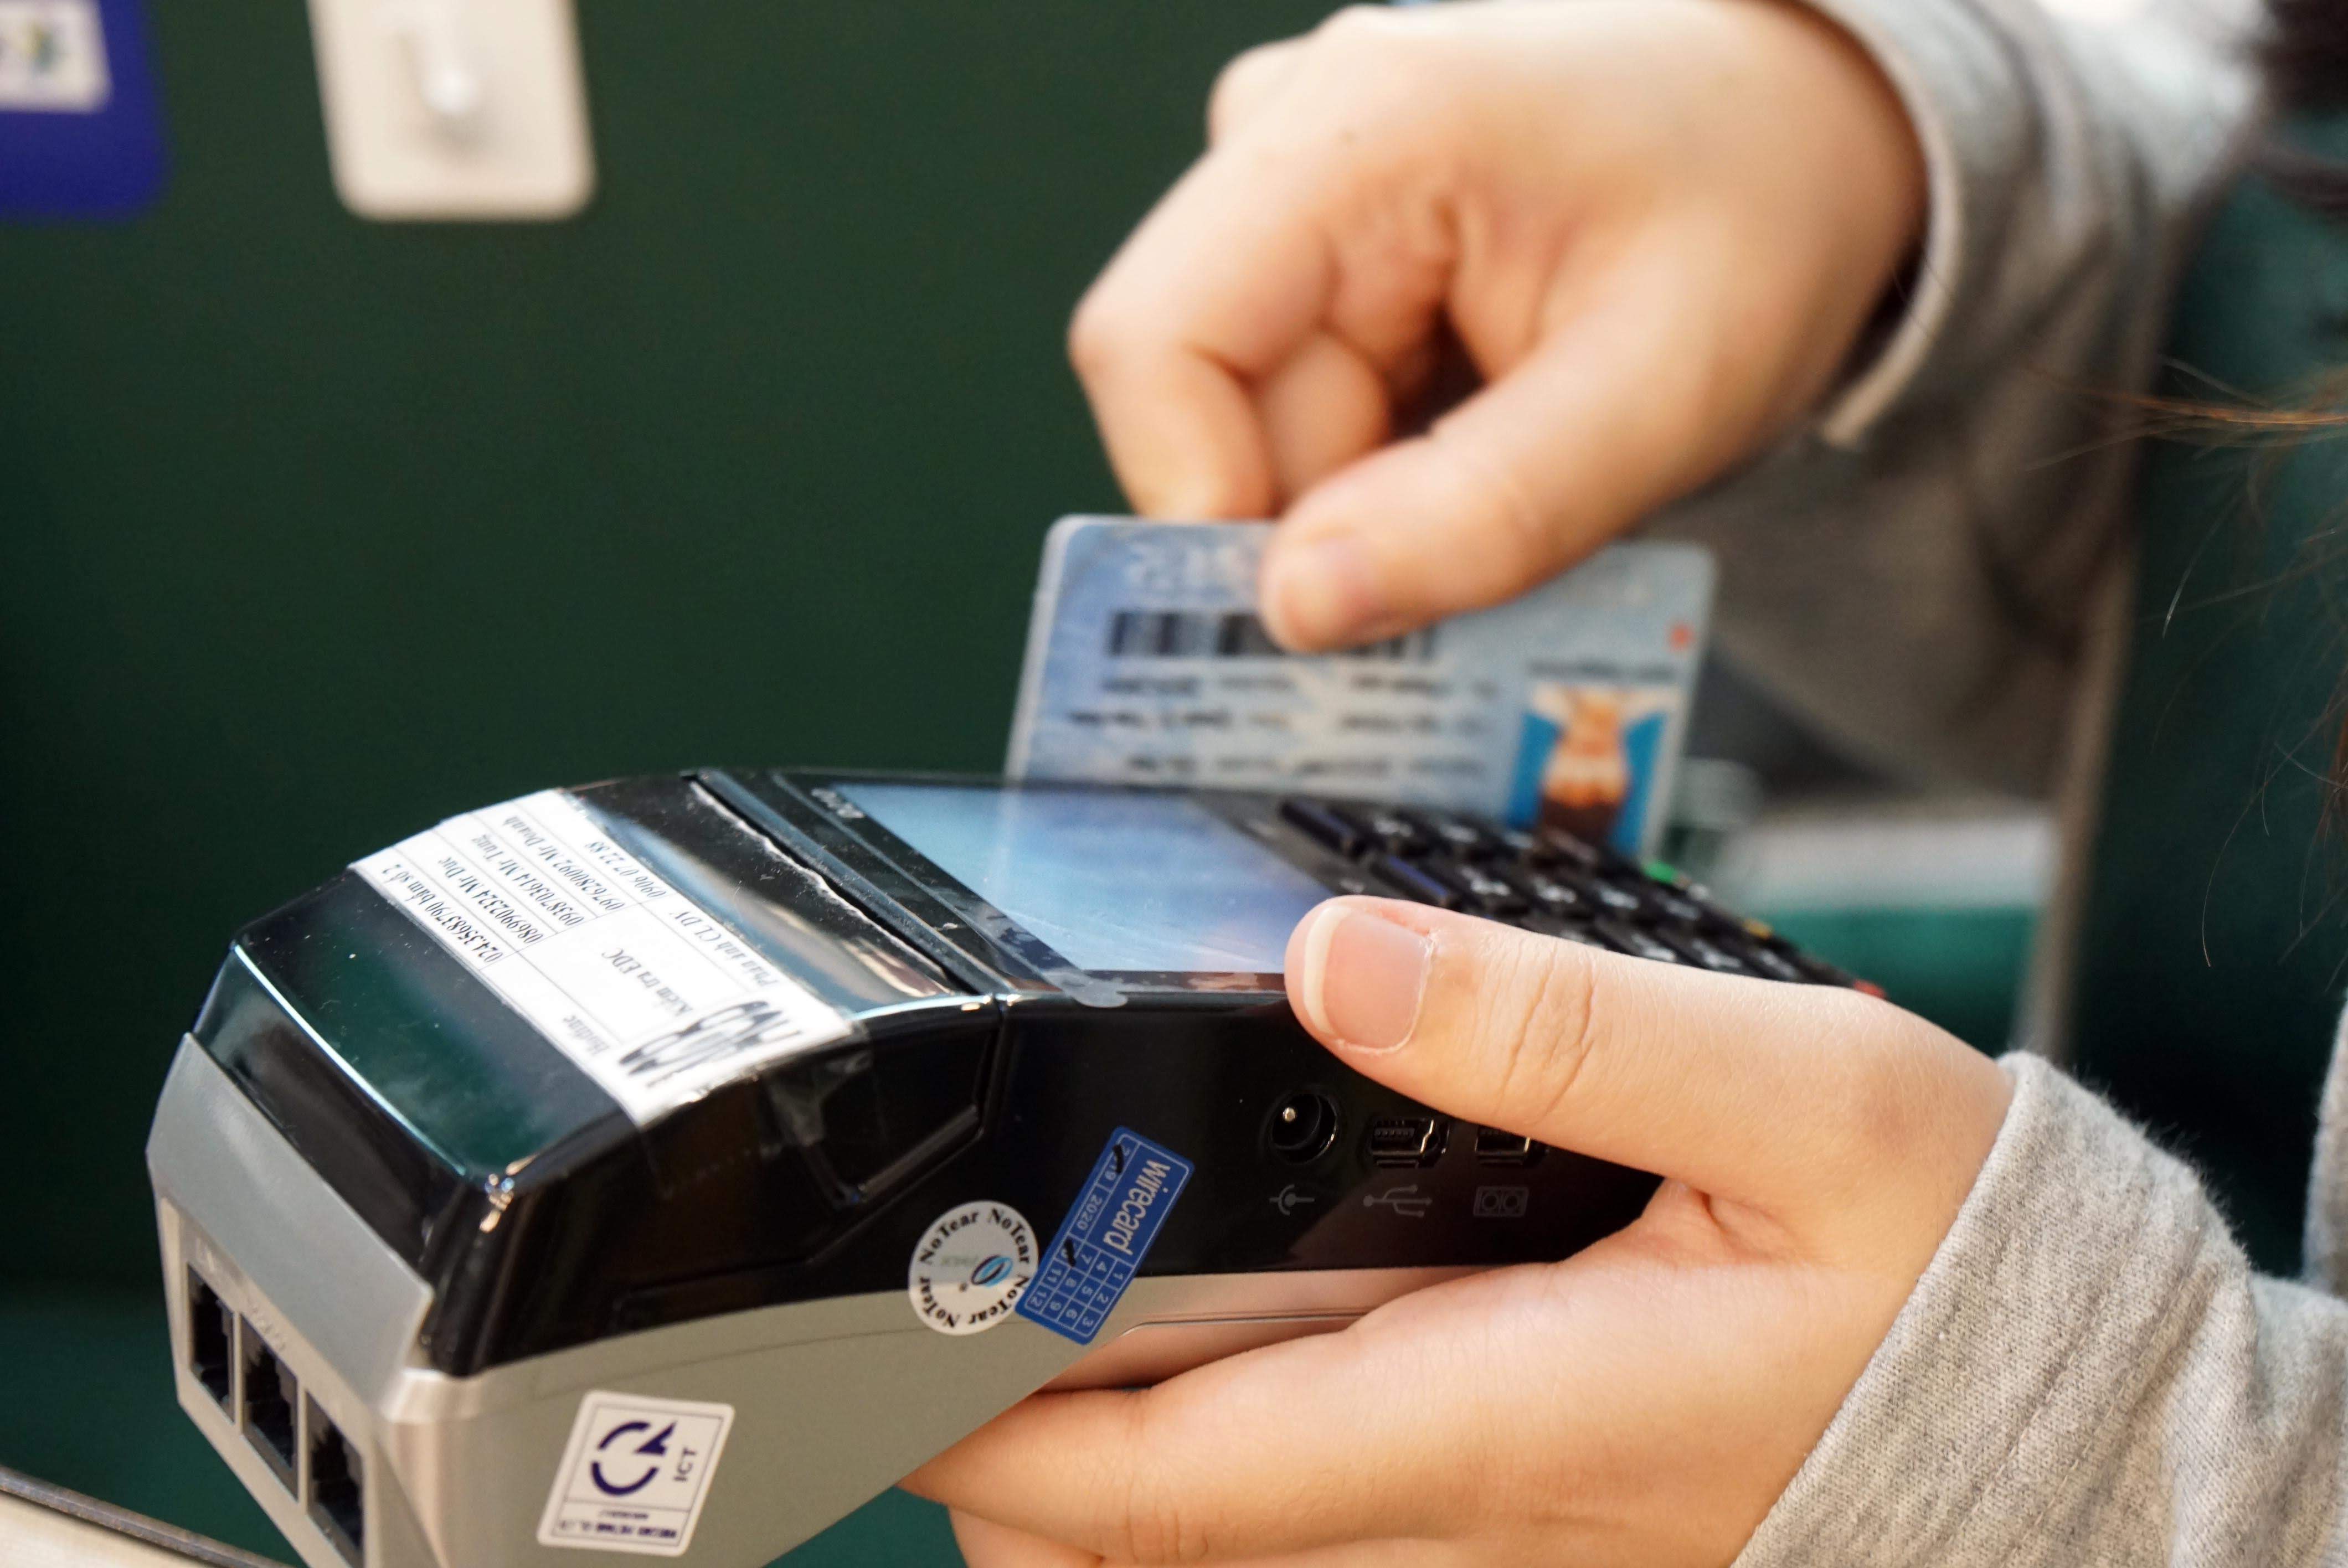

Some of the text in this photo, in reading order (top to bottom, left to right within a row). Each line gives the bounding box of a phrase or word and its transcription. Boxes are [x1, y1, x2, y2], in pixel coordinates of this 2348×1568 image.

[537, 844, 562, 862] Mr
[382, 864, 401, 874] 2
[500, 859, 523, 876] Mr
[553, 860, 625, 910] 0976280092
[437, 857, 543, 943] 0869902324 Mr Duc
[512, 873, 584, 926] 0938703614
[670, 912, 702, 926] DV
[425, 902, 503, 962] 024.35683790
[695, 926, 721, 941] CL
[602, 950, 641, 973] EDC
[1077, 1194, 1103, 1230] 2020
[1103, 1160, 1171, 1256] wirecard
[1081, 1254, 1093, 1264] 7
[919, 1208, 1031, 1328] NoTear NoTear NoTear NoTear
[1096, 1261, 1108, 1272] 4
[1047, 1268, 1062, 1282] 11
[1065, 1277, 1077, 1287] 8
[1113, 1273, 1124, 1281] 1
[1082, 1286, 1093, 1296] 5
[1031, 1291, 1047, 1307] 12
[1050, 1301, 1062, 1311] 9
[1097, 1294, 1109, 1304] 2
[1065, 1309, 1078, 1319] 6
[1082, 1317, 1094, 1328] 3
